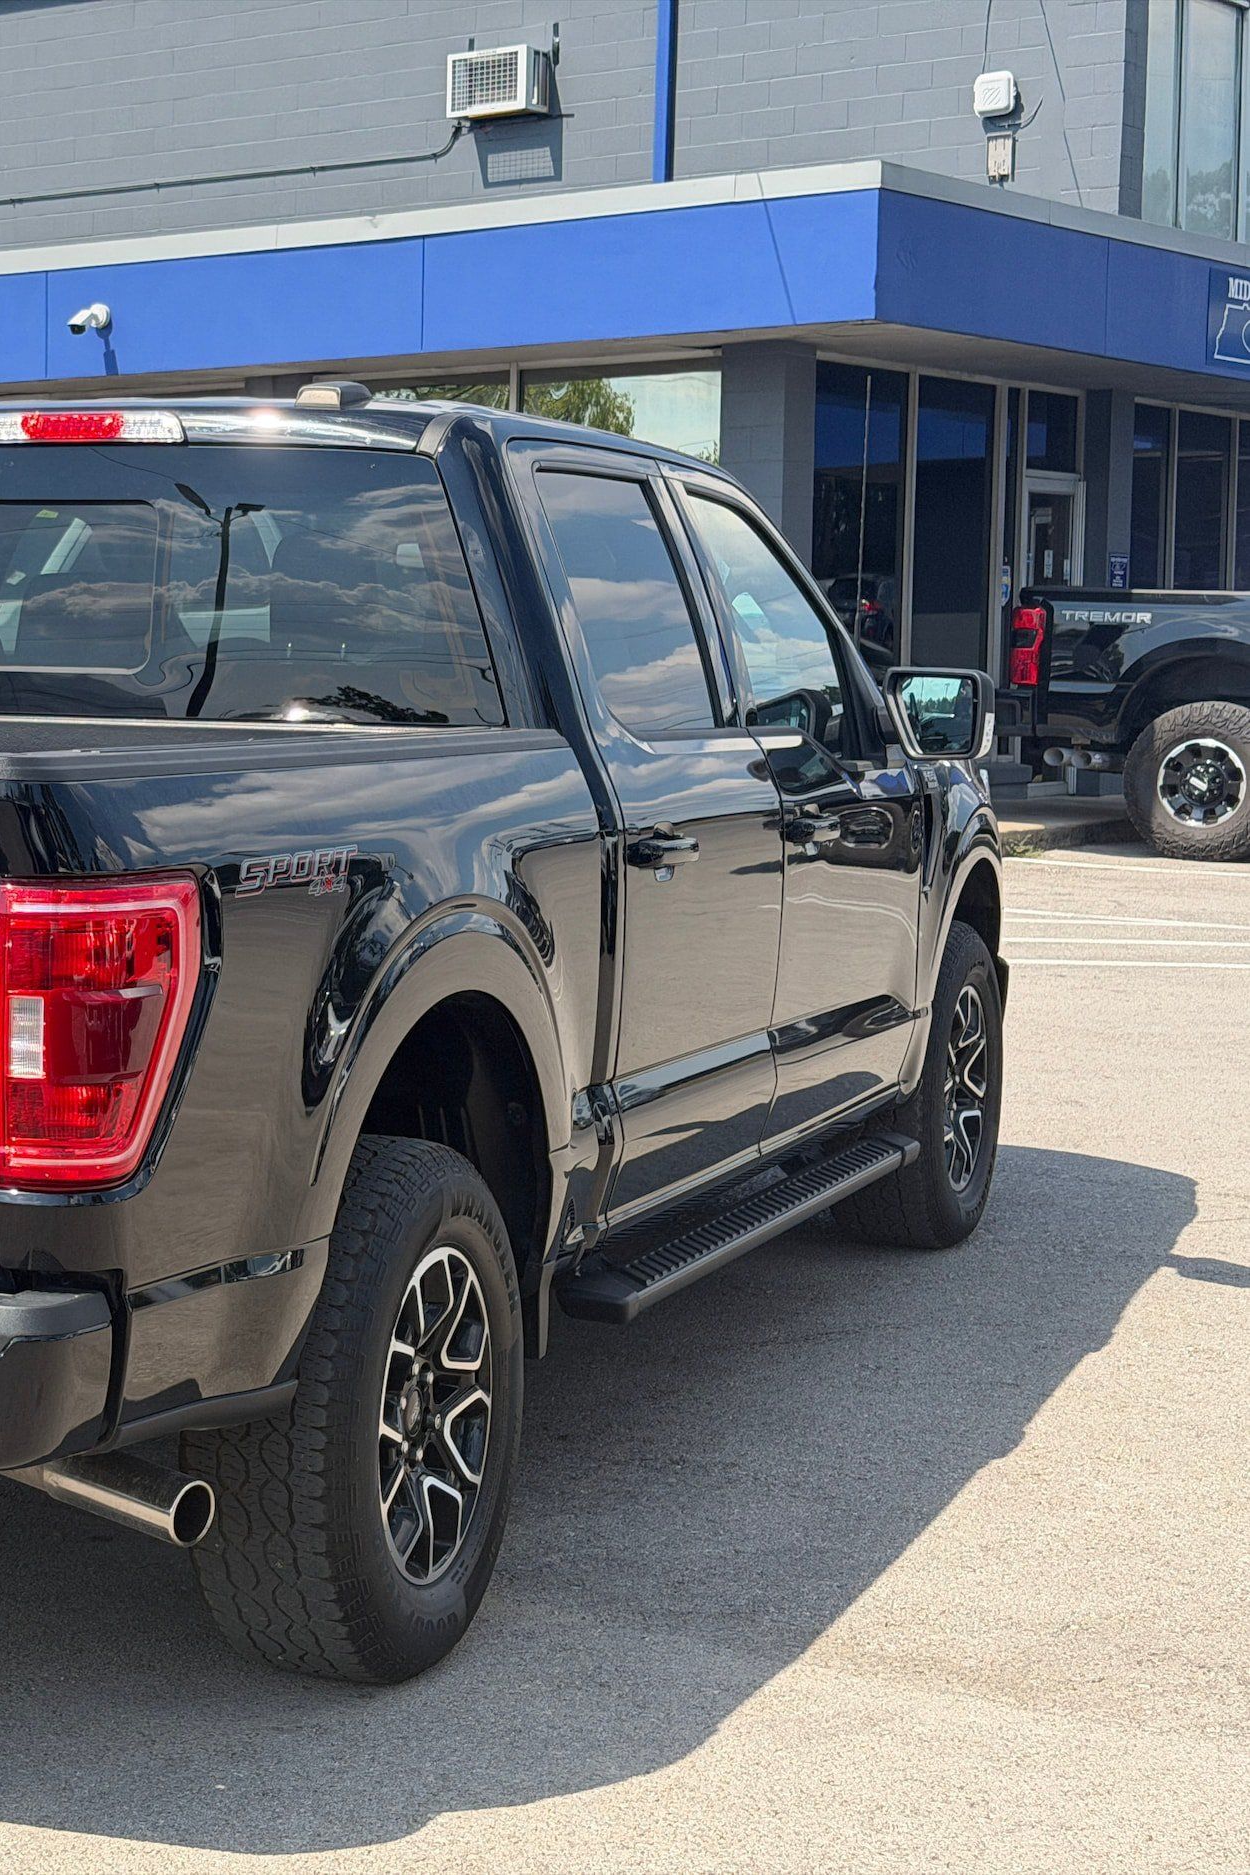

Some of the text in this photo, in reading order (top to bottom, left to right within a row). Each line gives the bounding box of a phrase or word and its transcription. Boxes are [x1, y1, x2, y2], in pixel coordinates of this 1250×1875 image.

[1228, 276, 1250, 301] MID
[1061, 609, 1152, 625] TREMOR
[234, 844, 358, 898] SPORT
